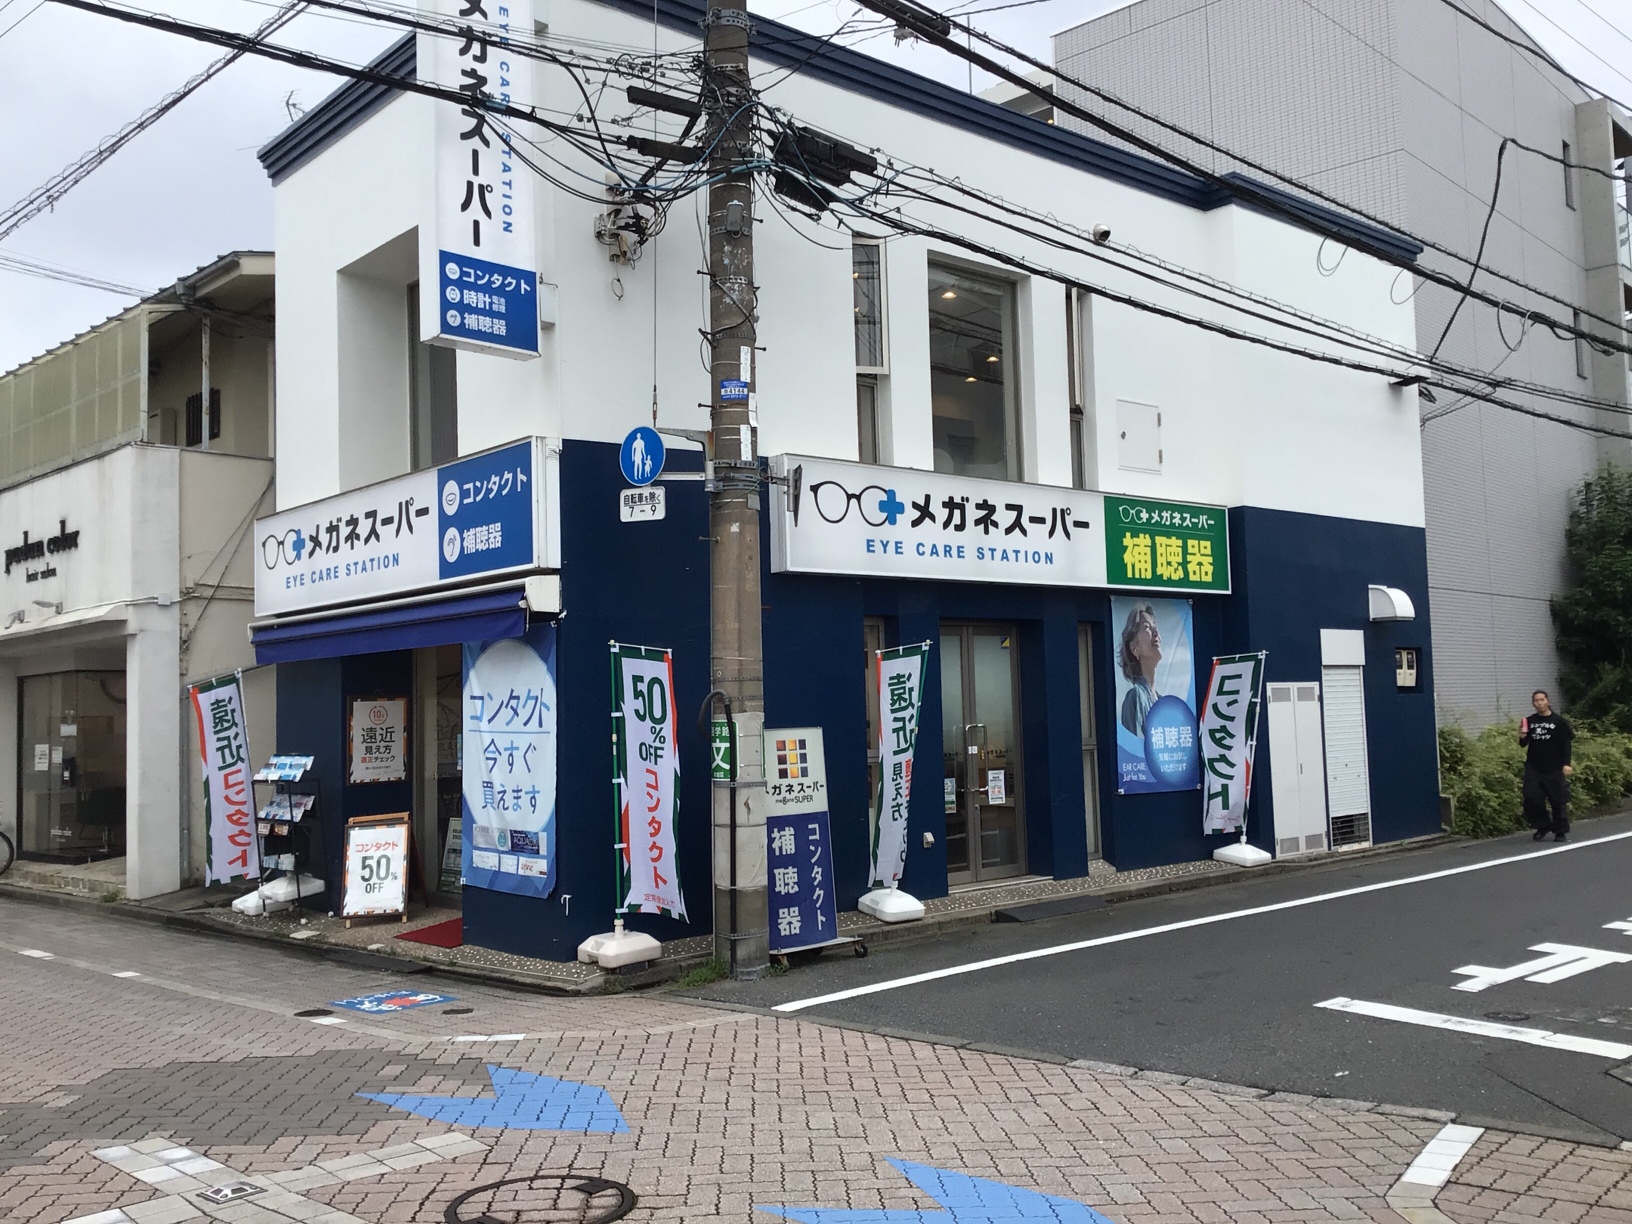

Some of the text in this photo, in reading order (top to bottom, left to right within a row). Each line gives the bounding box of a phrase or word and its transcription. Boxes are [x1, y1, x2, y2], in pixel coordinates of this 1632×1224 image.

[459, 0, 493, 247] メガネスーパー
[502, 132, 513, 233] STATION
[462, 267, 531, 295] コンタクト
[463, 289, 491, 310] 時計
[464, 312, 506, 336] 補聴器
[463, 467, 527, 505] コンタクト
[624, 491, 661, 505] 自転車を除く
[308, 497, 430, 559] メガネスーパー
[911, 493, 1089, 541] メガネスーパー
[1151, 509, 1214, 529] メガネスーパー
[463, 522, 502, 555] 補聴器
[866, 539, 1053, 565] EYE CARE STATION
[286, 552, 399, 589] EYE CARE STATION
[1123, 532, 1213, 582] 補聴器
[469, 687, 550, 728] コンタクト
[361, 726, 396, 744] 遠近
[364, 744, 392, 755] 見え方
[1151, 726, 1192, 749] 補聴器
[483, 738, 537, 774] 今すぐ
[638, 742, 664, 765] OFF
[482, 781, 541, 814] 買えます
[766, 781, 824, 796] ガネスーパー
[645, 768, 668, 889] コンタクト
[355, 841, 399, 853] コンタクト
[365, 882, 384, 894] OFF
[771, 826, 801, 936] 補聴器
[808, 823, 826, 930] コンタクト
